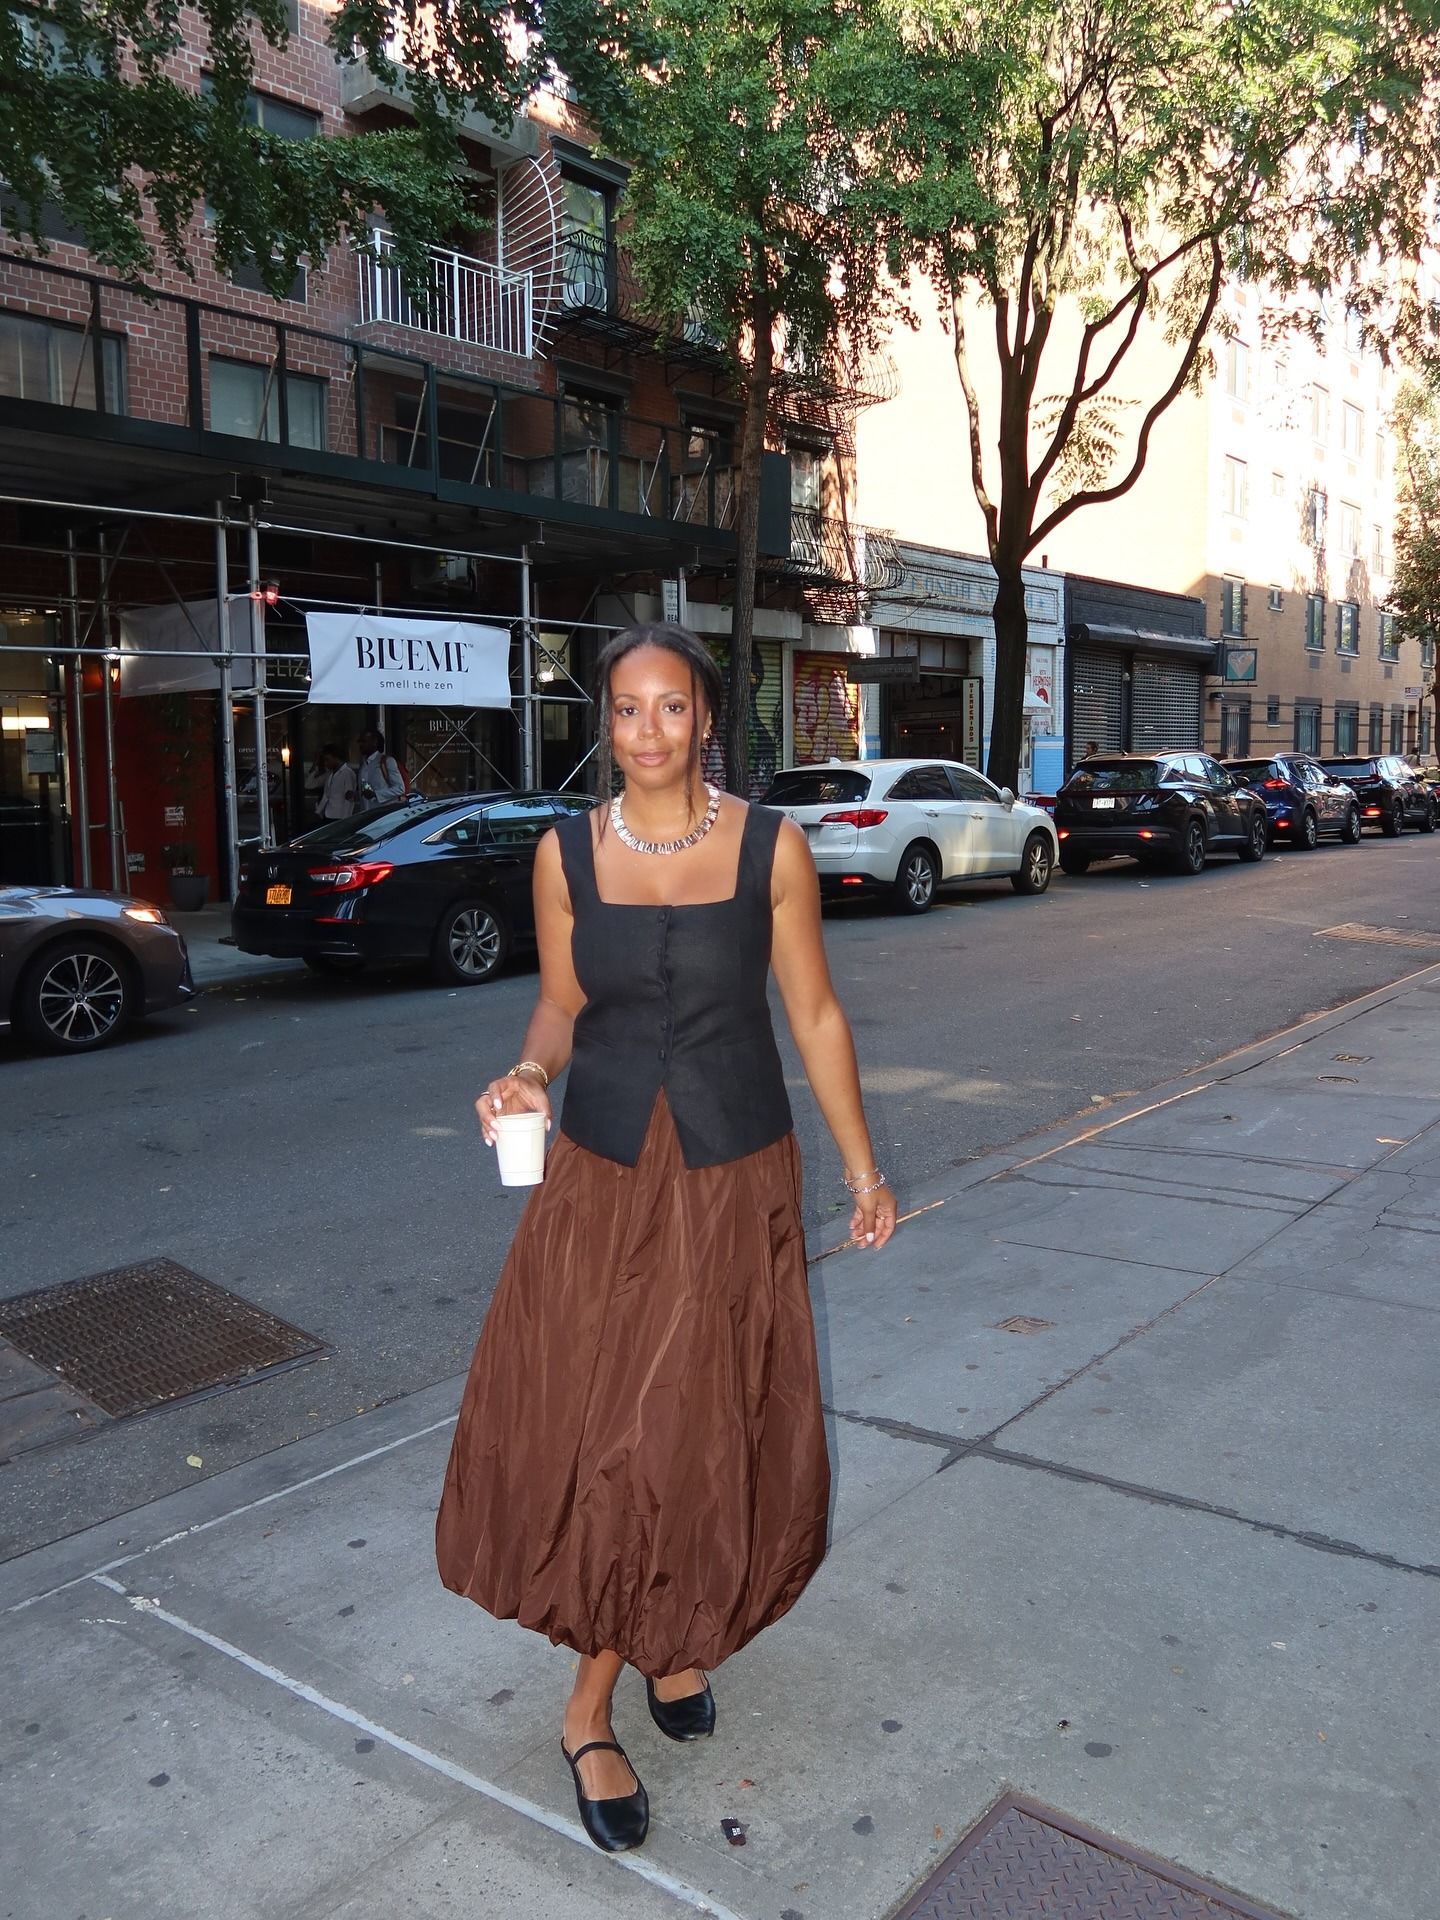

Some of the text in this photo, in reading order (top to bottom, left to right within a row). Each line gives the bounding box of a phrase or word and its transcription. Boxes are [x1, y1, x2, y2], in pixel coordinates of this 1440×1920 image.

[380, 680, 453, 690] smell the zen
